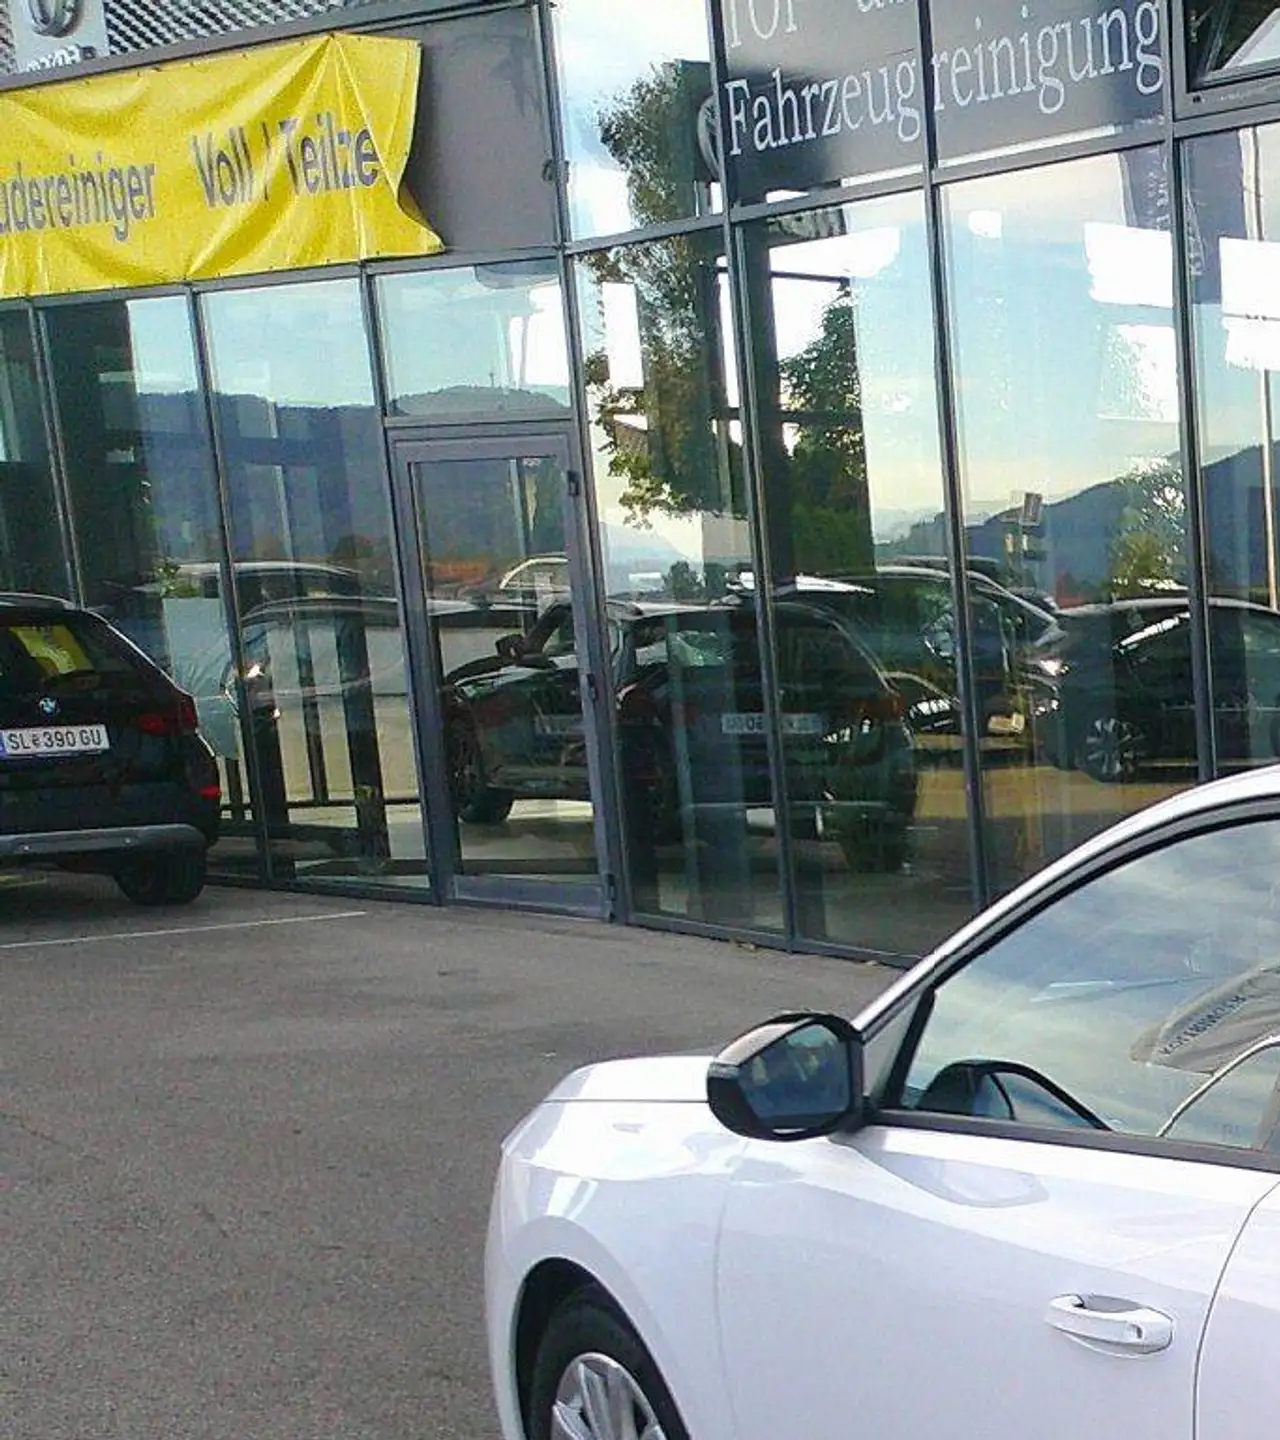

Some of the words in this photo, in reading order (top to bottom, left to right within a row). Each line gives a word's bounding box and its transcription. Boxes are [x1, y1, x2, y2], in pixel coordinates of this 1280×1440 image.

[724, 2, 1164, 156] Fahrzeugreinigung
[192, 126, 255, 208] Voll
[8, 732, 31, 750] SL
[43, 731, 76, 748] 390
[80, 729, 100, 746] GU
